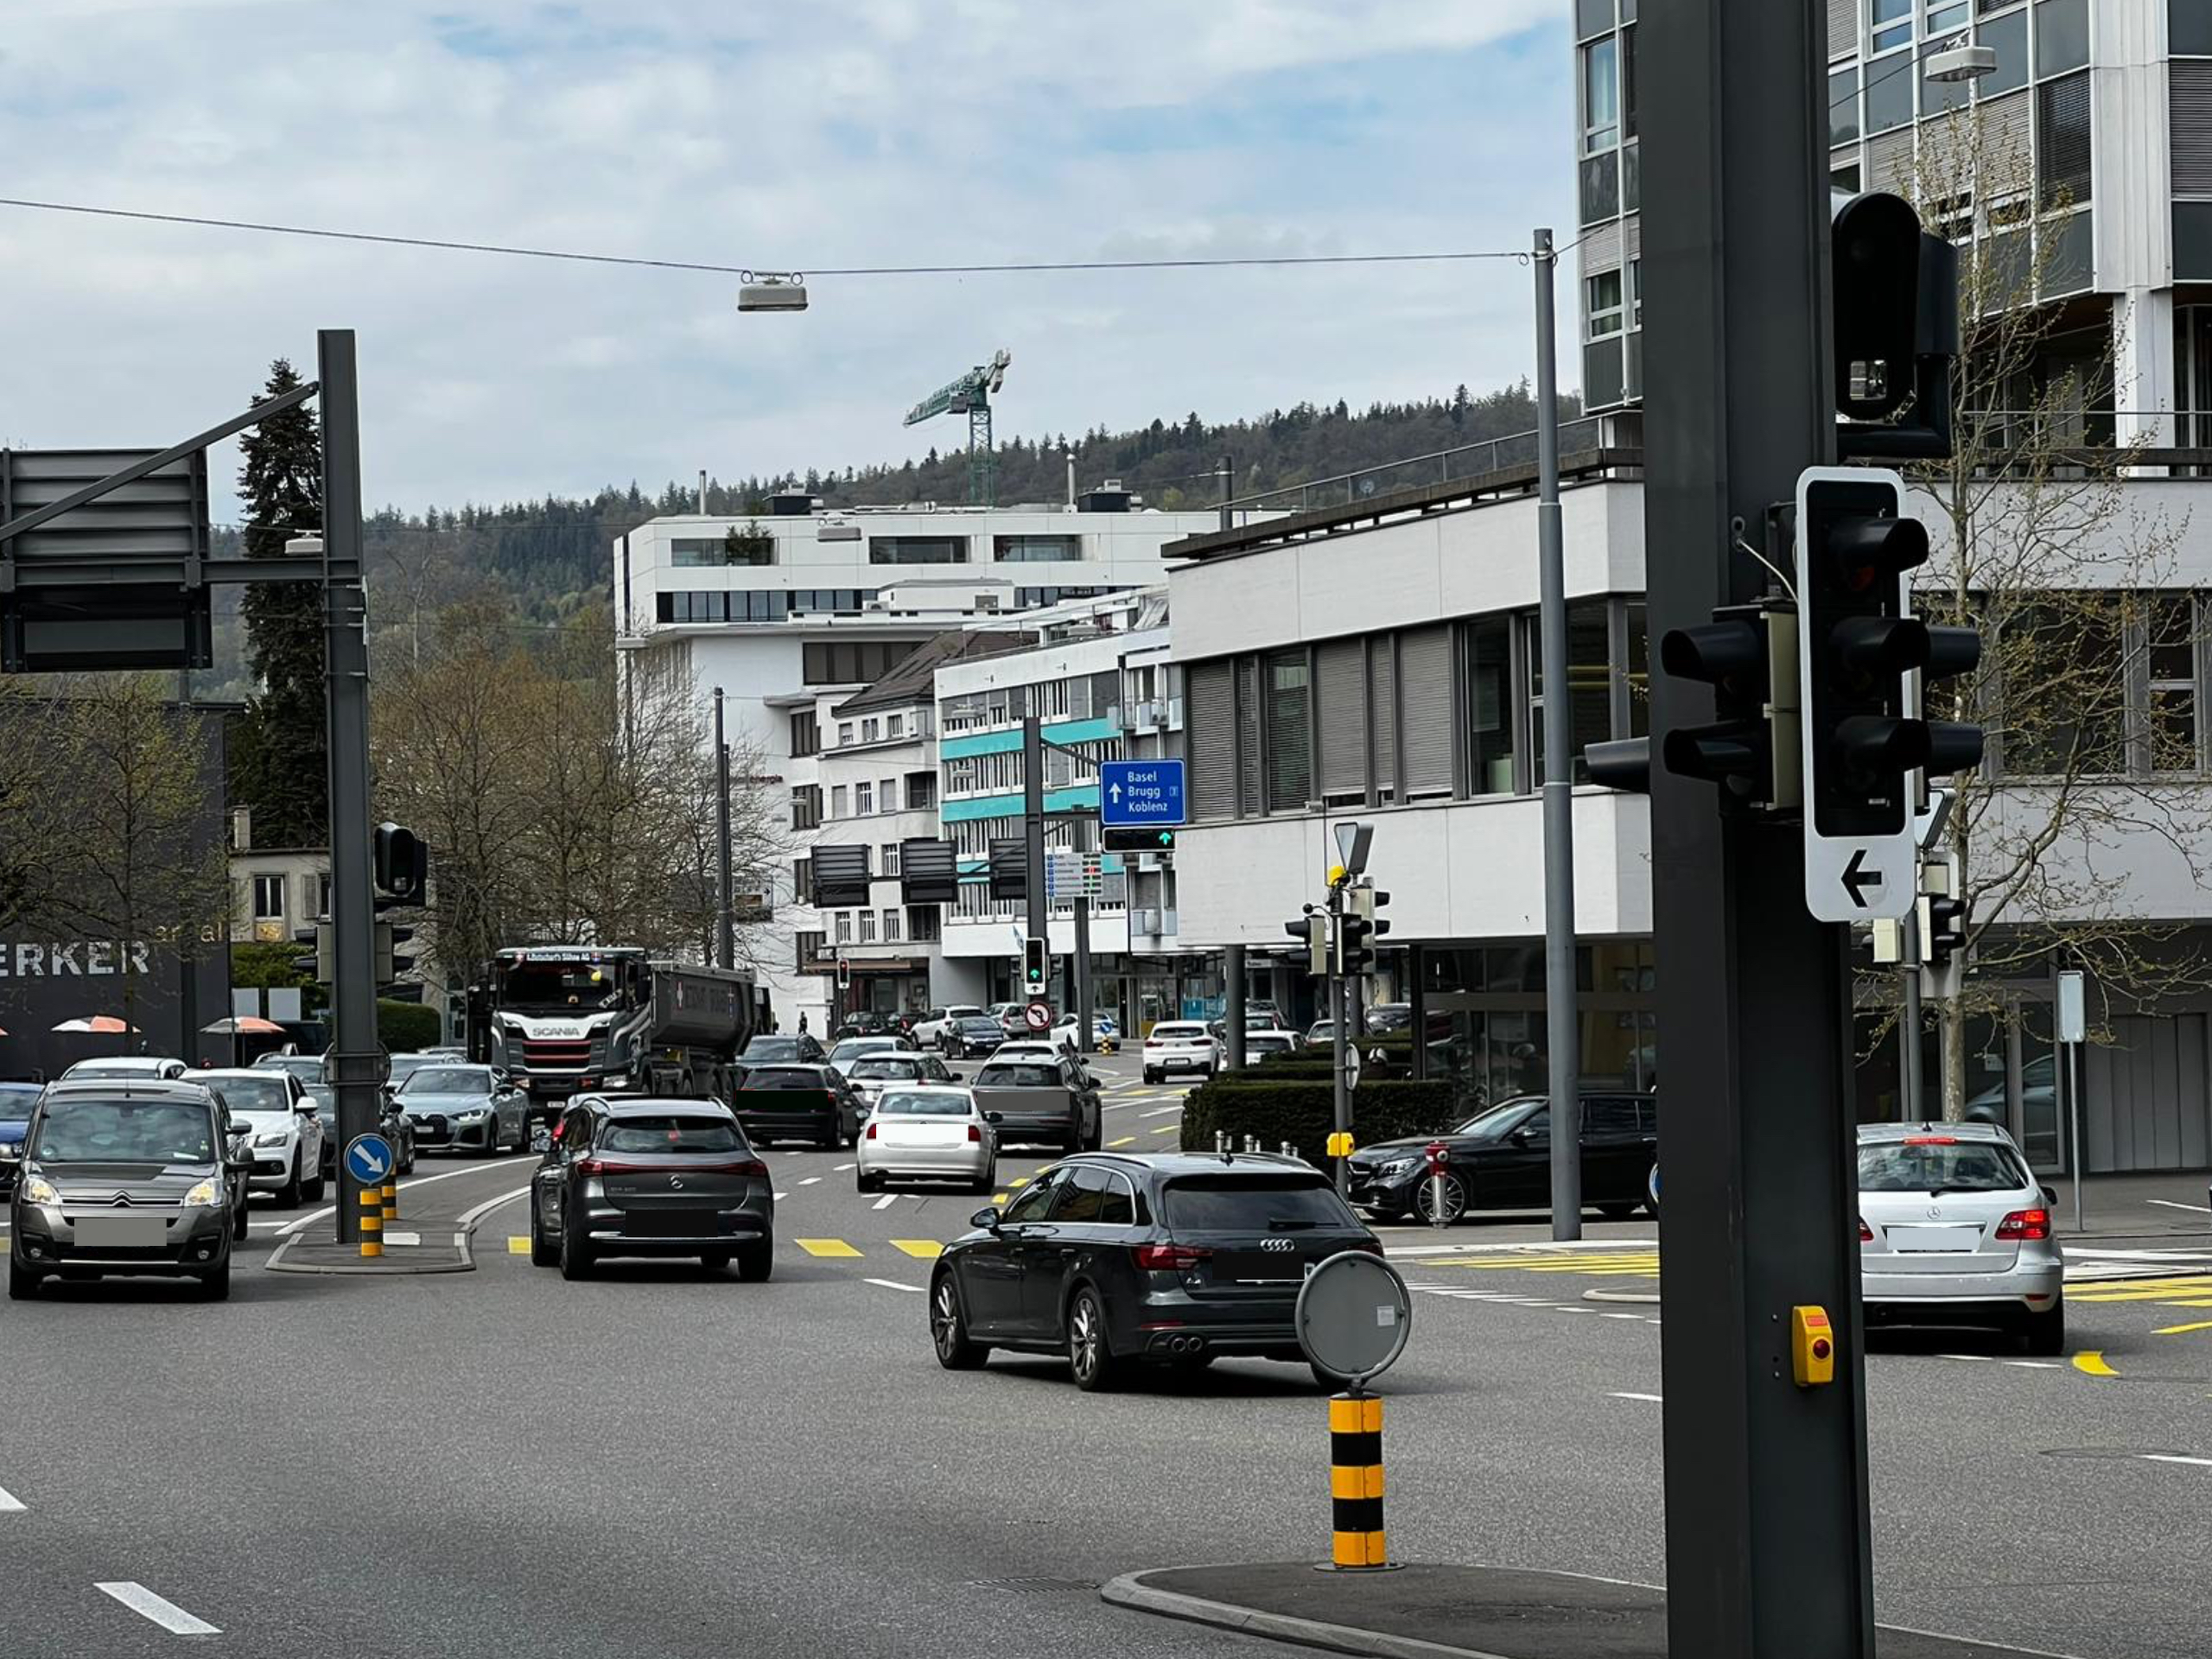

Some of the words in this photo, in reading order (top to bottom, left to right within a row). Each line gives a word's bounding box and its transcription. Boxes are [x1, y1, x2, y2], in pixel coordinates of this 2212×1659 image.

[1128, 770, 1157, 783] Basel
[1128, 785, 1160, 799] Brugg
[1128, 800, 1168, 812] Koblenz
[532, 1027, 580, 1036] SCANIA
